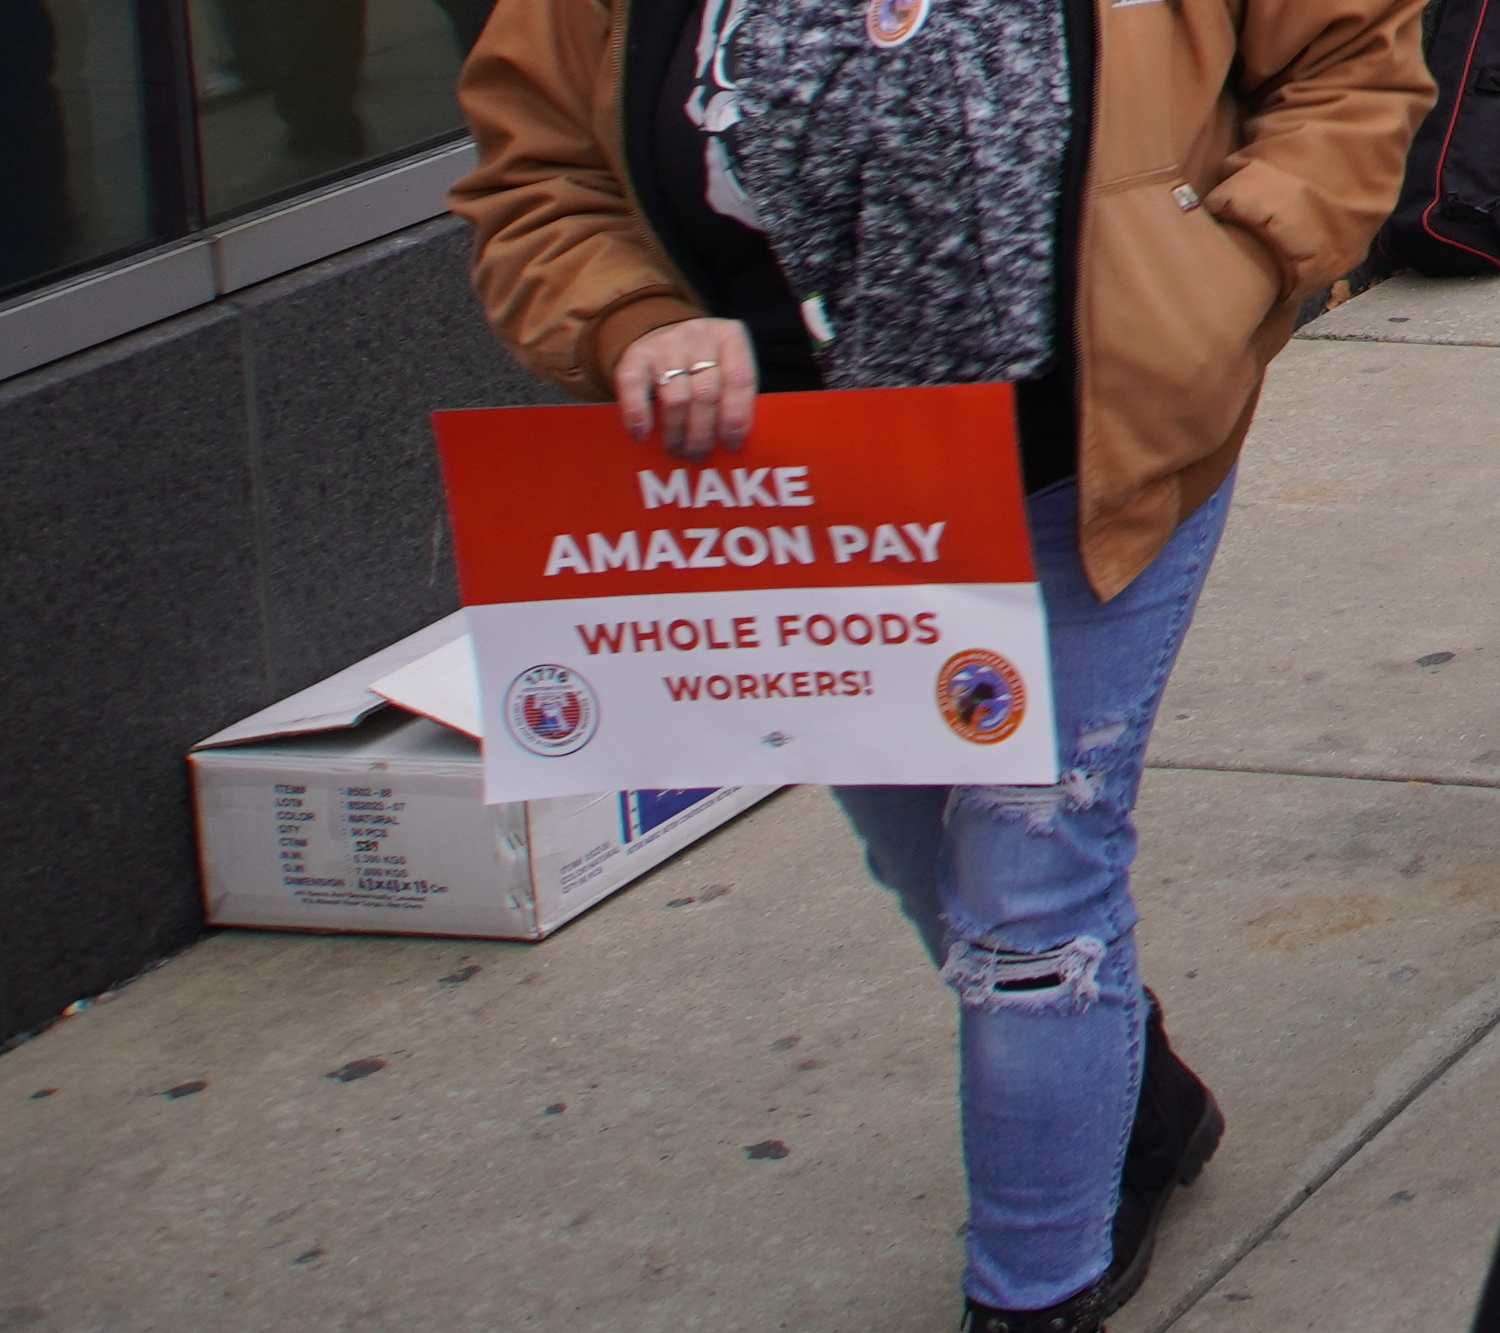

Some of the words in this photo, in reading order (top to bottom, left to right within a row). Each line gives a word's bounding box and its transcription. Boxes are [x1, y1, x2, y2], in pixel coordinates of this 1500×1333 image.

[637, 465, 816, 510] MAKE
[542, 524, 815, 576] AMAZON
[827, 521, 947, 564] PAY
[576, 615, 762, 655] WHOLE
[777, 611, 942, 648] FOODS
[522, 667, 570, 686] 1776
[663, 670, 875, 703] WORKERS!
